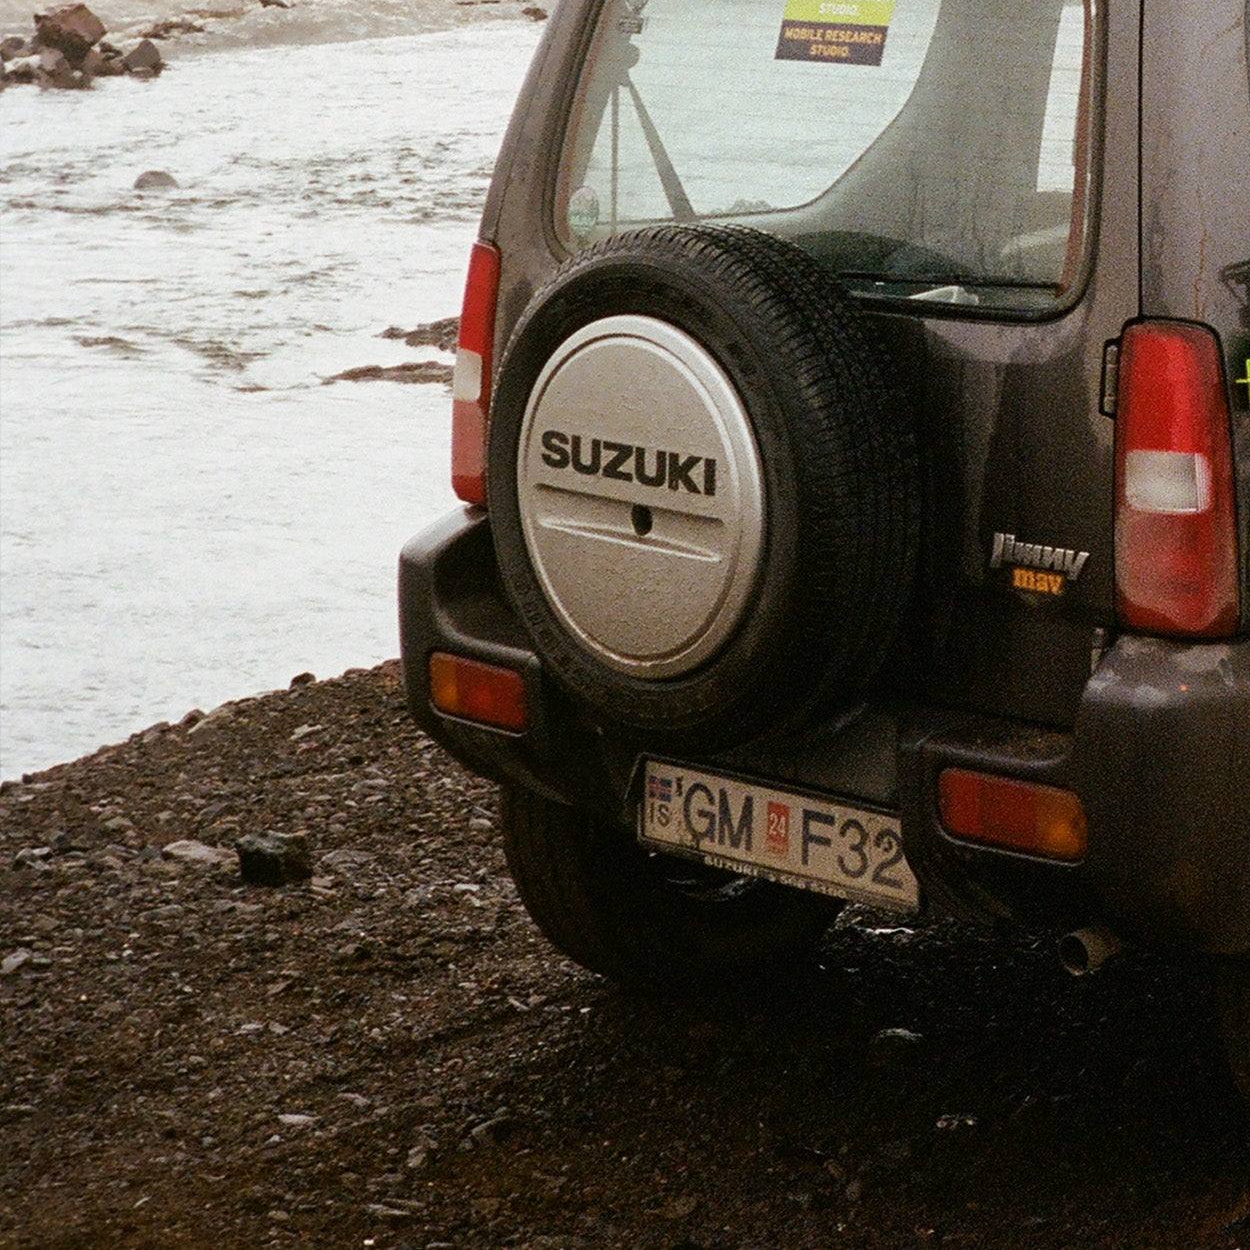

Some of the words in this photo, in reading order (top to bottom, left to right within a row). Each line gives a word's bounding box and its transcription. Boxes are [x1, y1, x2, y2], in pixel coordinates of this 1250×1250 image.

[784, 28, 823, 41] MOBILE
[824, 29, 882, 45] RESEARCH
[541, 430, 717, 496] SUZUKI
[648, 801, 671, 827] IS
[683, 782, 753, 851] GM
[768, 812, 787, 832] 24
[801, 808, 903, 891] F32
